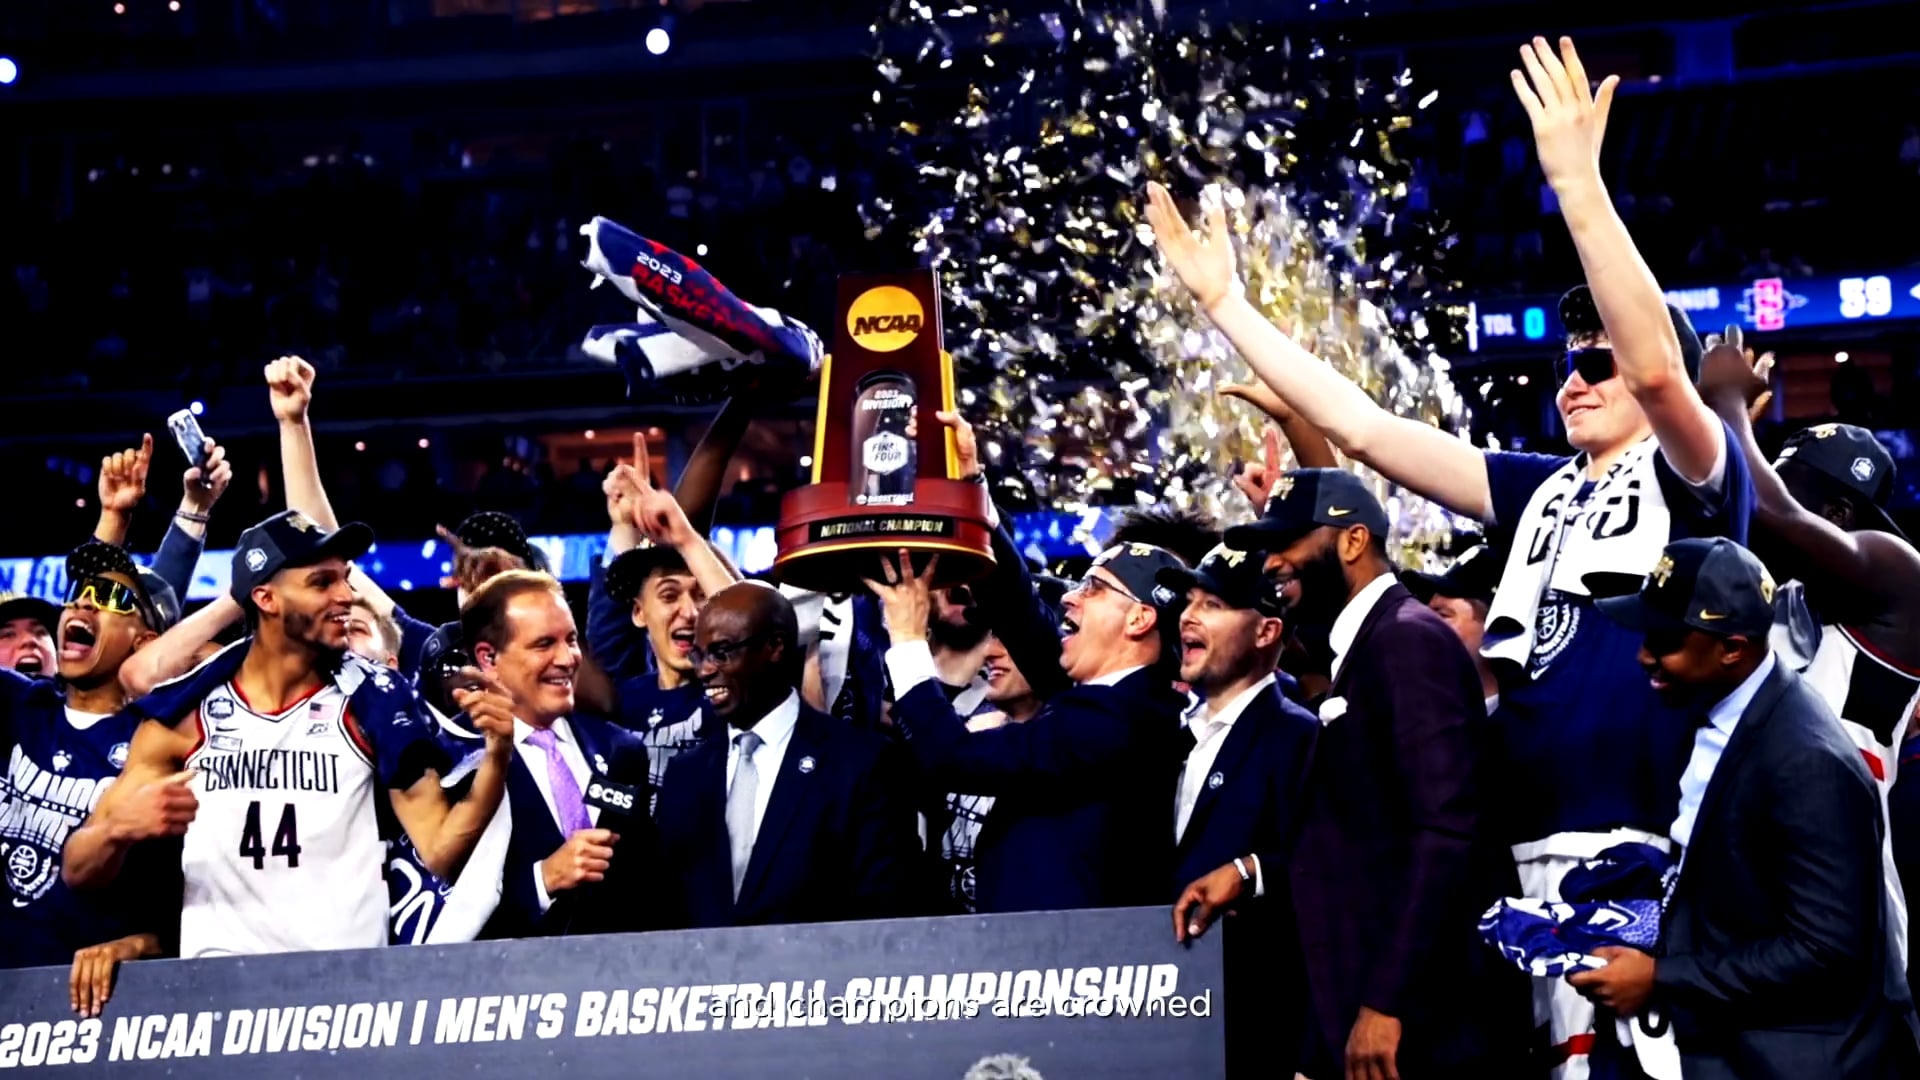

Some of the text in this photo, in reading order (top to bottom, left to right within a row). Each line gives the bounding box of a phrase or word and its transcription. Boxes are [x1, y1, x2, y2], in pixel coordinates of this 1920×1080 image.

[635, 250, 683, 286] 2023
[1839, 275, 1893, 318] 59
[853, 314, 921, 336] NCAA
[1523, 306, 1546, 339] 0
[820, 519, 944, 538] NATIONAL CHAMPION
[199, 748, 339, 794] CONNECTICUT
[601, 787, 634, 809] CBS
[239, 800, 302, 870] 44
[0, 964, 1179, 1068] 2023 NCAA DIVISION I MEN'S BASKETBALL CHAMPIONSHIP
